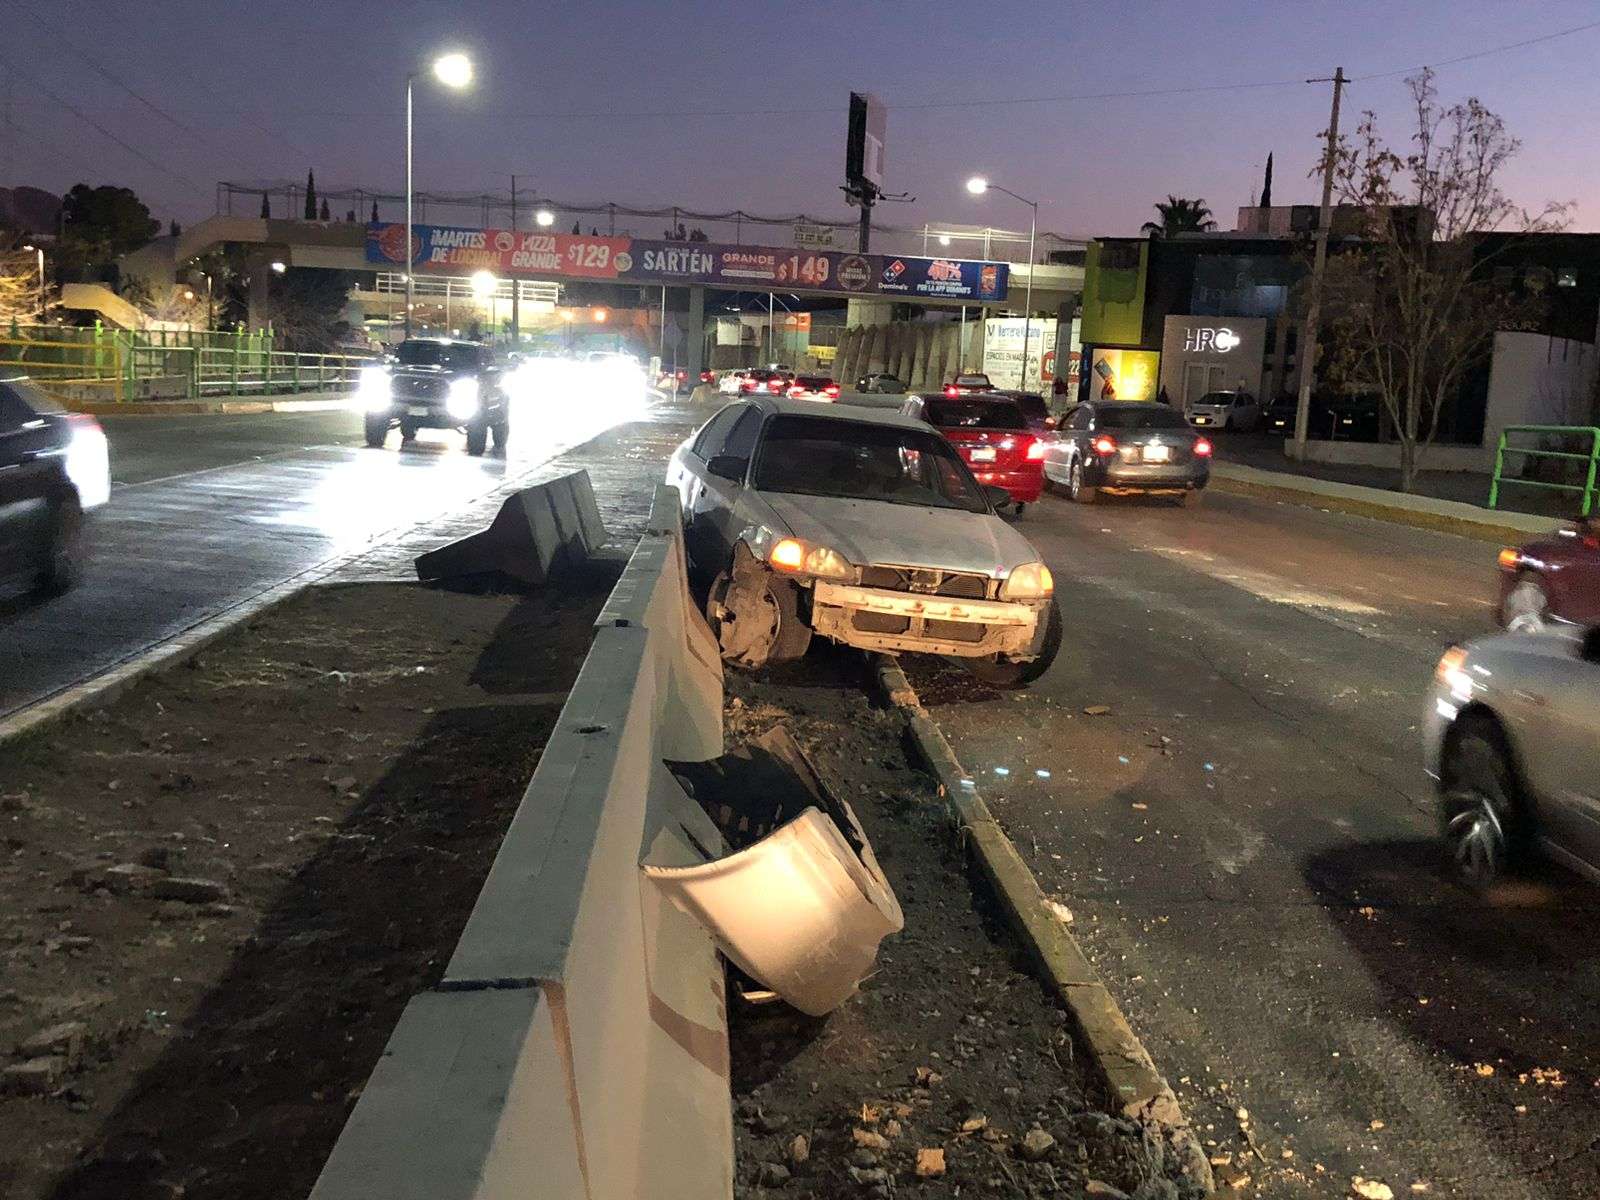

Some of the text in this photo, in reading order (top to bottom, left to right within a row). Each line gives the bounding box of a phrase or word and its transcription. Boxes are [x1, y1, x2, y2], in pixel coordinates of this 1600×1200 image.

[521, 234, 556, 253] PIZZA
[430, 247, 449, 263] DE
[511, 250, 562, 269] GRANDE
[568, 243, 610, 268] $129
[642, 248, 713, 274] SARTÉN
[722, 253, 775, 265] GRANDE
[778, 255, 829, 281] $149
